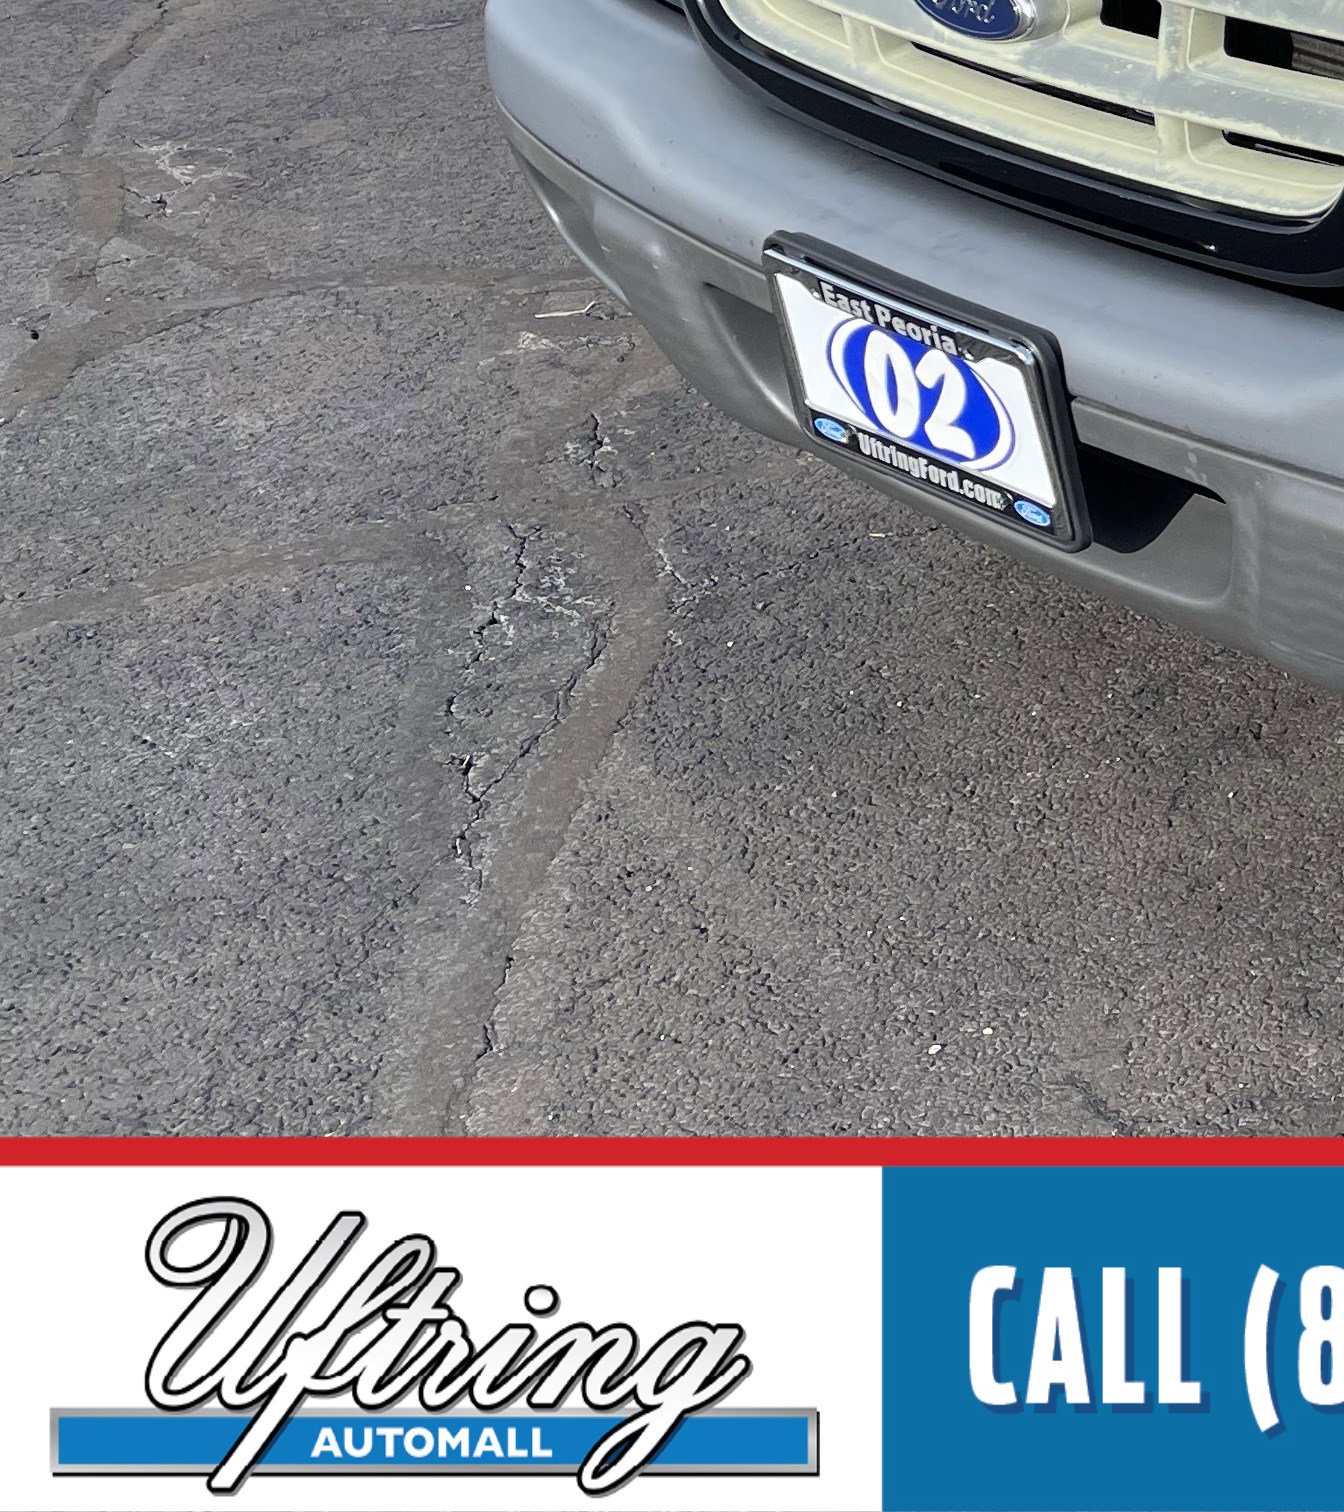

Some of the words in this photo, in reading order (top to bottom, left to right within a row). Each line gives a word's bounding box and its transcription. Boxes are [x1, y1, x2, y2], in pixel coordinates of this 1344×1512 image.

[819, 279, 875, 325] East
[874, 303, 960, 357] Peoria
[863, 329, 977, 461] 02
